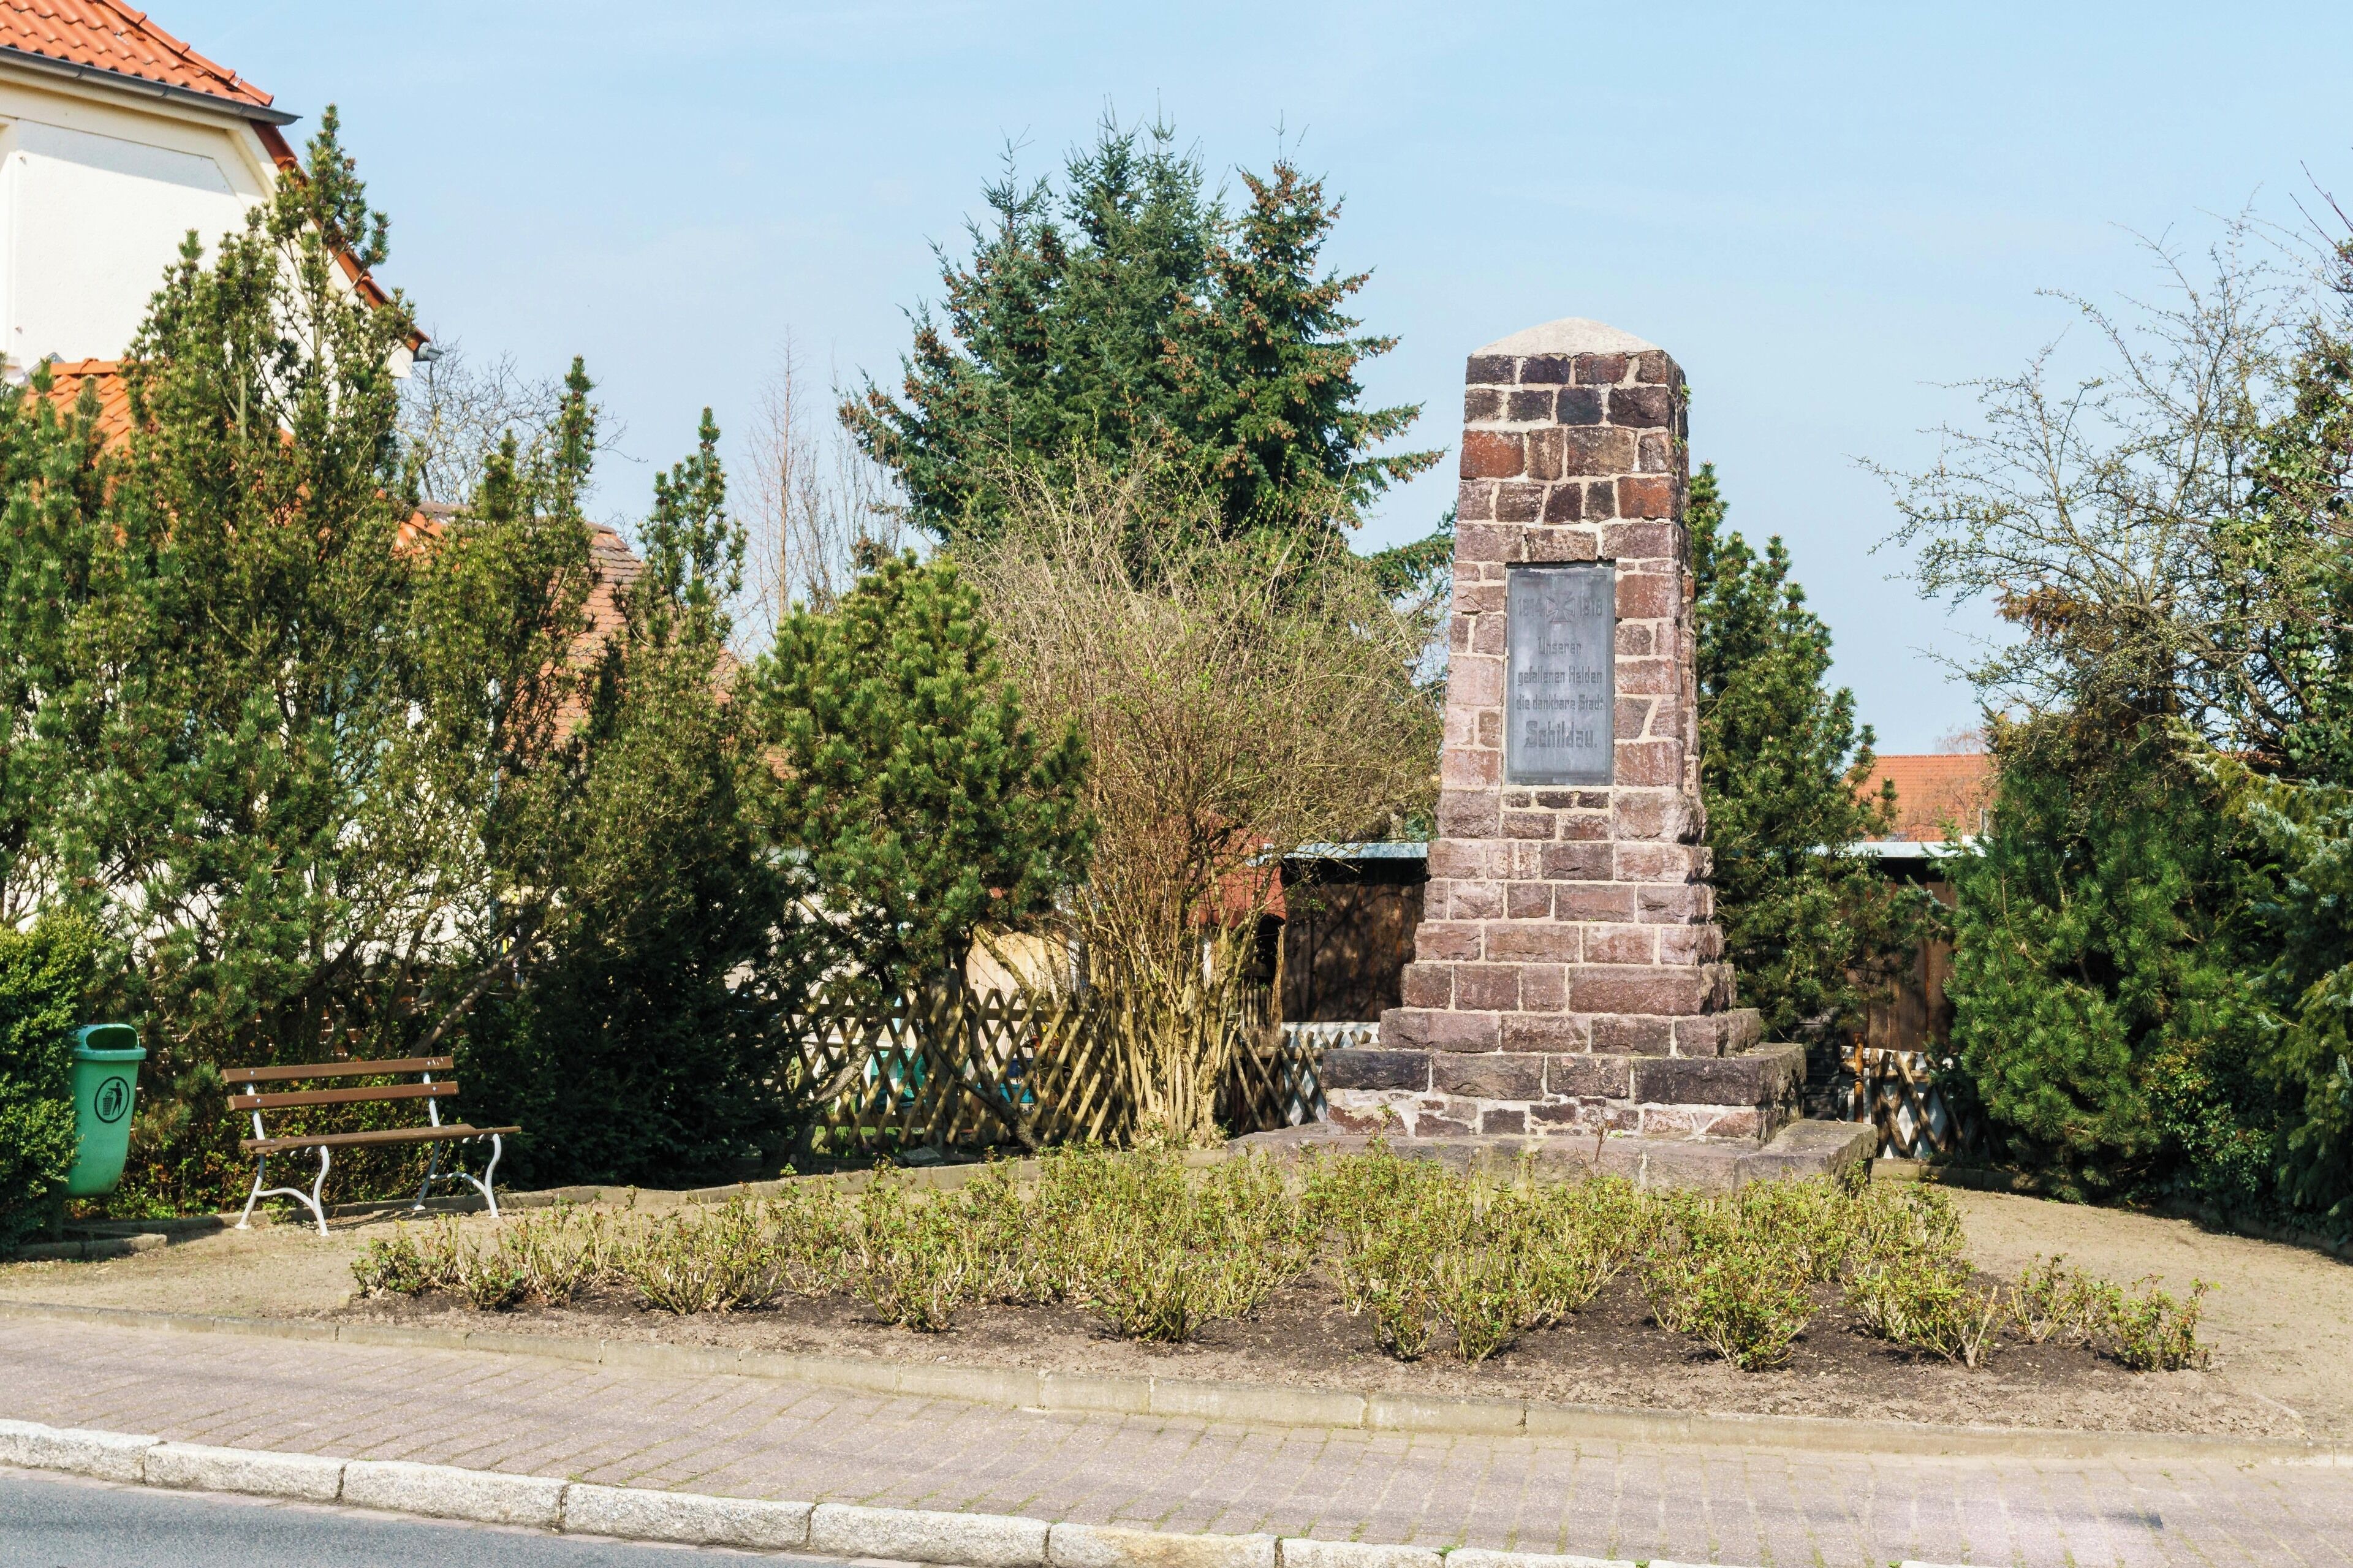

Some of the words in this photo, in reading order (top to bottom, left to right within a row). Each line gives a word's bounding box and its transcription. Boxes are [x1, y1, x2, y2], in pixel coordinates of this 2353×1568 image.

[1518, 599, 1543, 617] 1914
[1579, 597, 1603, 617] 1918
[1537, 637, 1582, 654] Unseren
[1517, 666, 1565, 686] gefallenen
[1568, 666, 1602, 683] Helden
[1516, 694, 1530, 710] die
[1533, 694, 1575, 710] dankbare
[1578, 694, 1604, 710] Stadt
[1525, 721, 1597, 748] Schildau.
